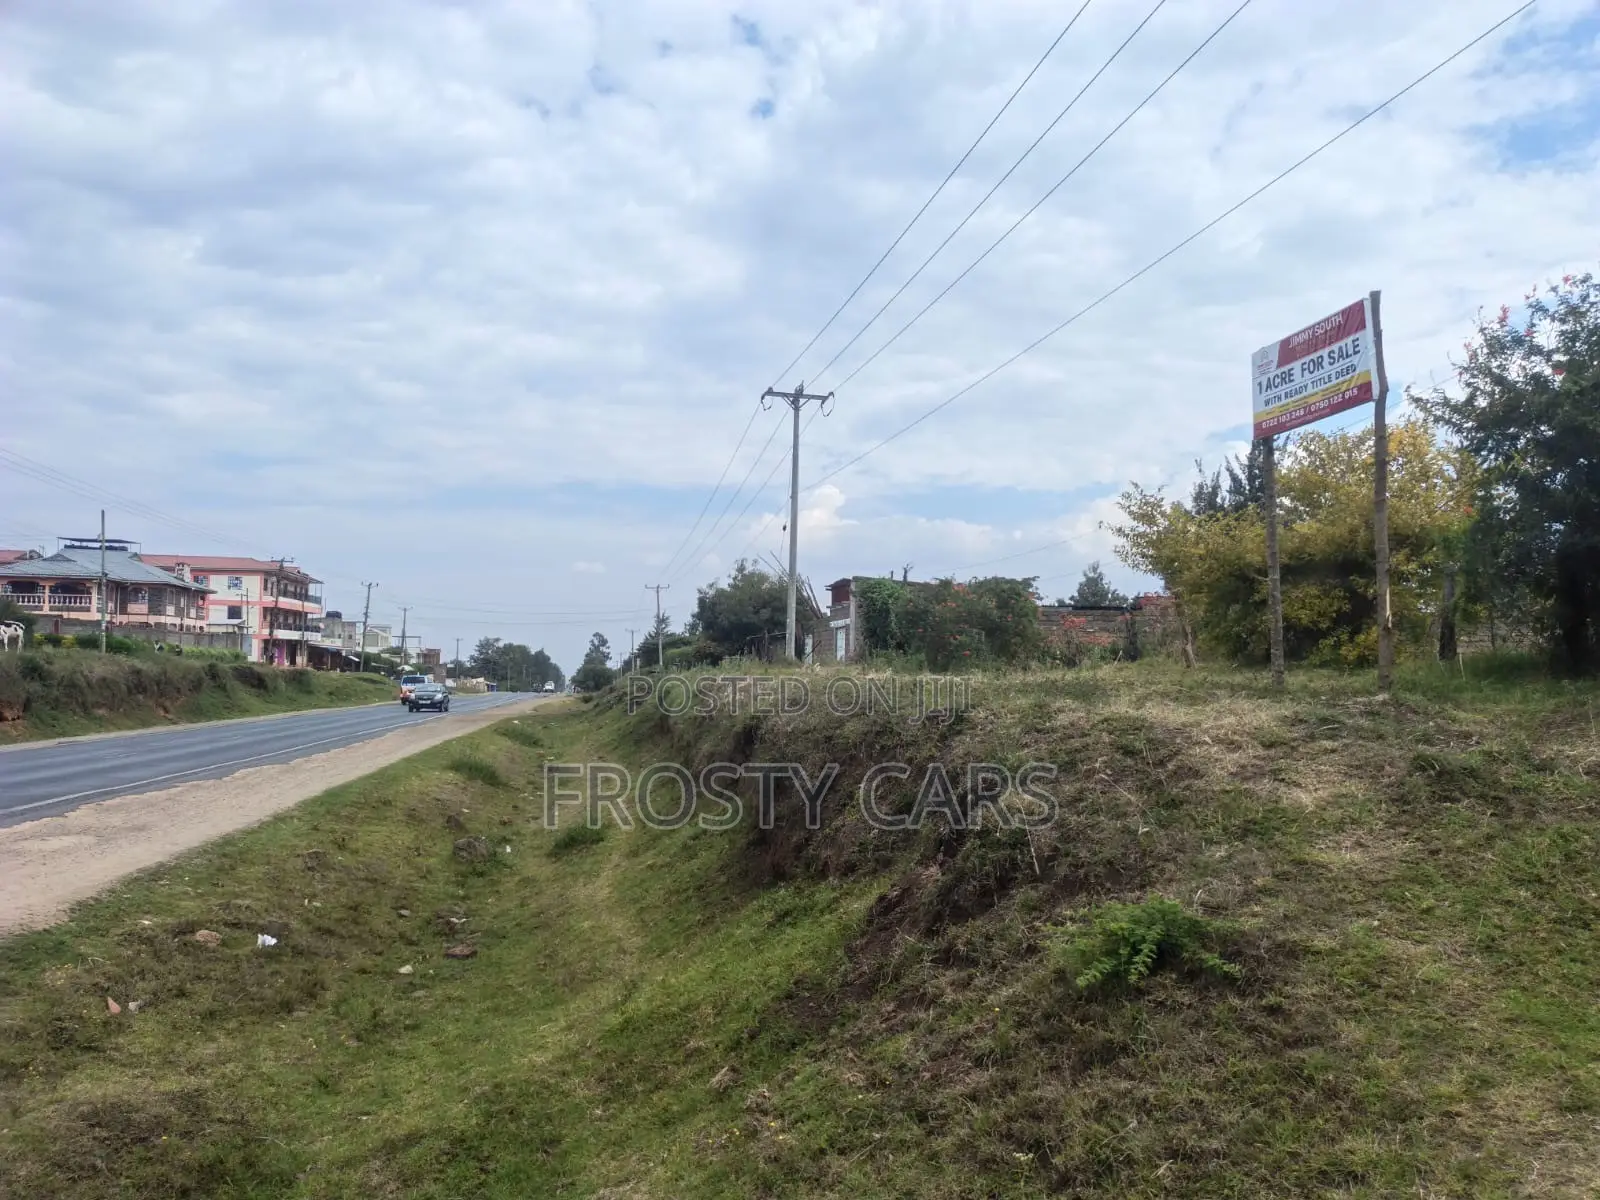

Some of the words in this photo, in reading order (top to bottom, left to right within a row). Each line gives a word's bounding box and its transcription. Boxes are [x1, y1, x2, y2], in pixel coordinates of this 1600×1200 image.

[1289, 327, 1313, 348] JIMMY
[1314, 314, 1343, 336] SOUTH
[1257, 381, 1263, 396] 1
[1264, 367, 1295, 393] ACRE
[1300, 354, 1325, 378] FOR
[1328, 337, 1361, 366] SALE
[1264, 393, 1282, 407] WITH
[1284, 383, 1309, 400] READY
[1311, 374, 1332, 390] TITLE
[1335, 364, 1357, 379] DEED
